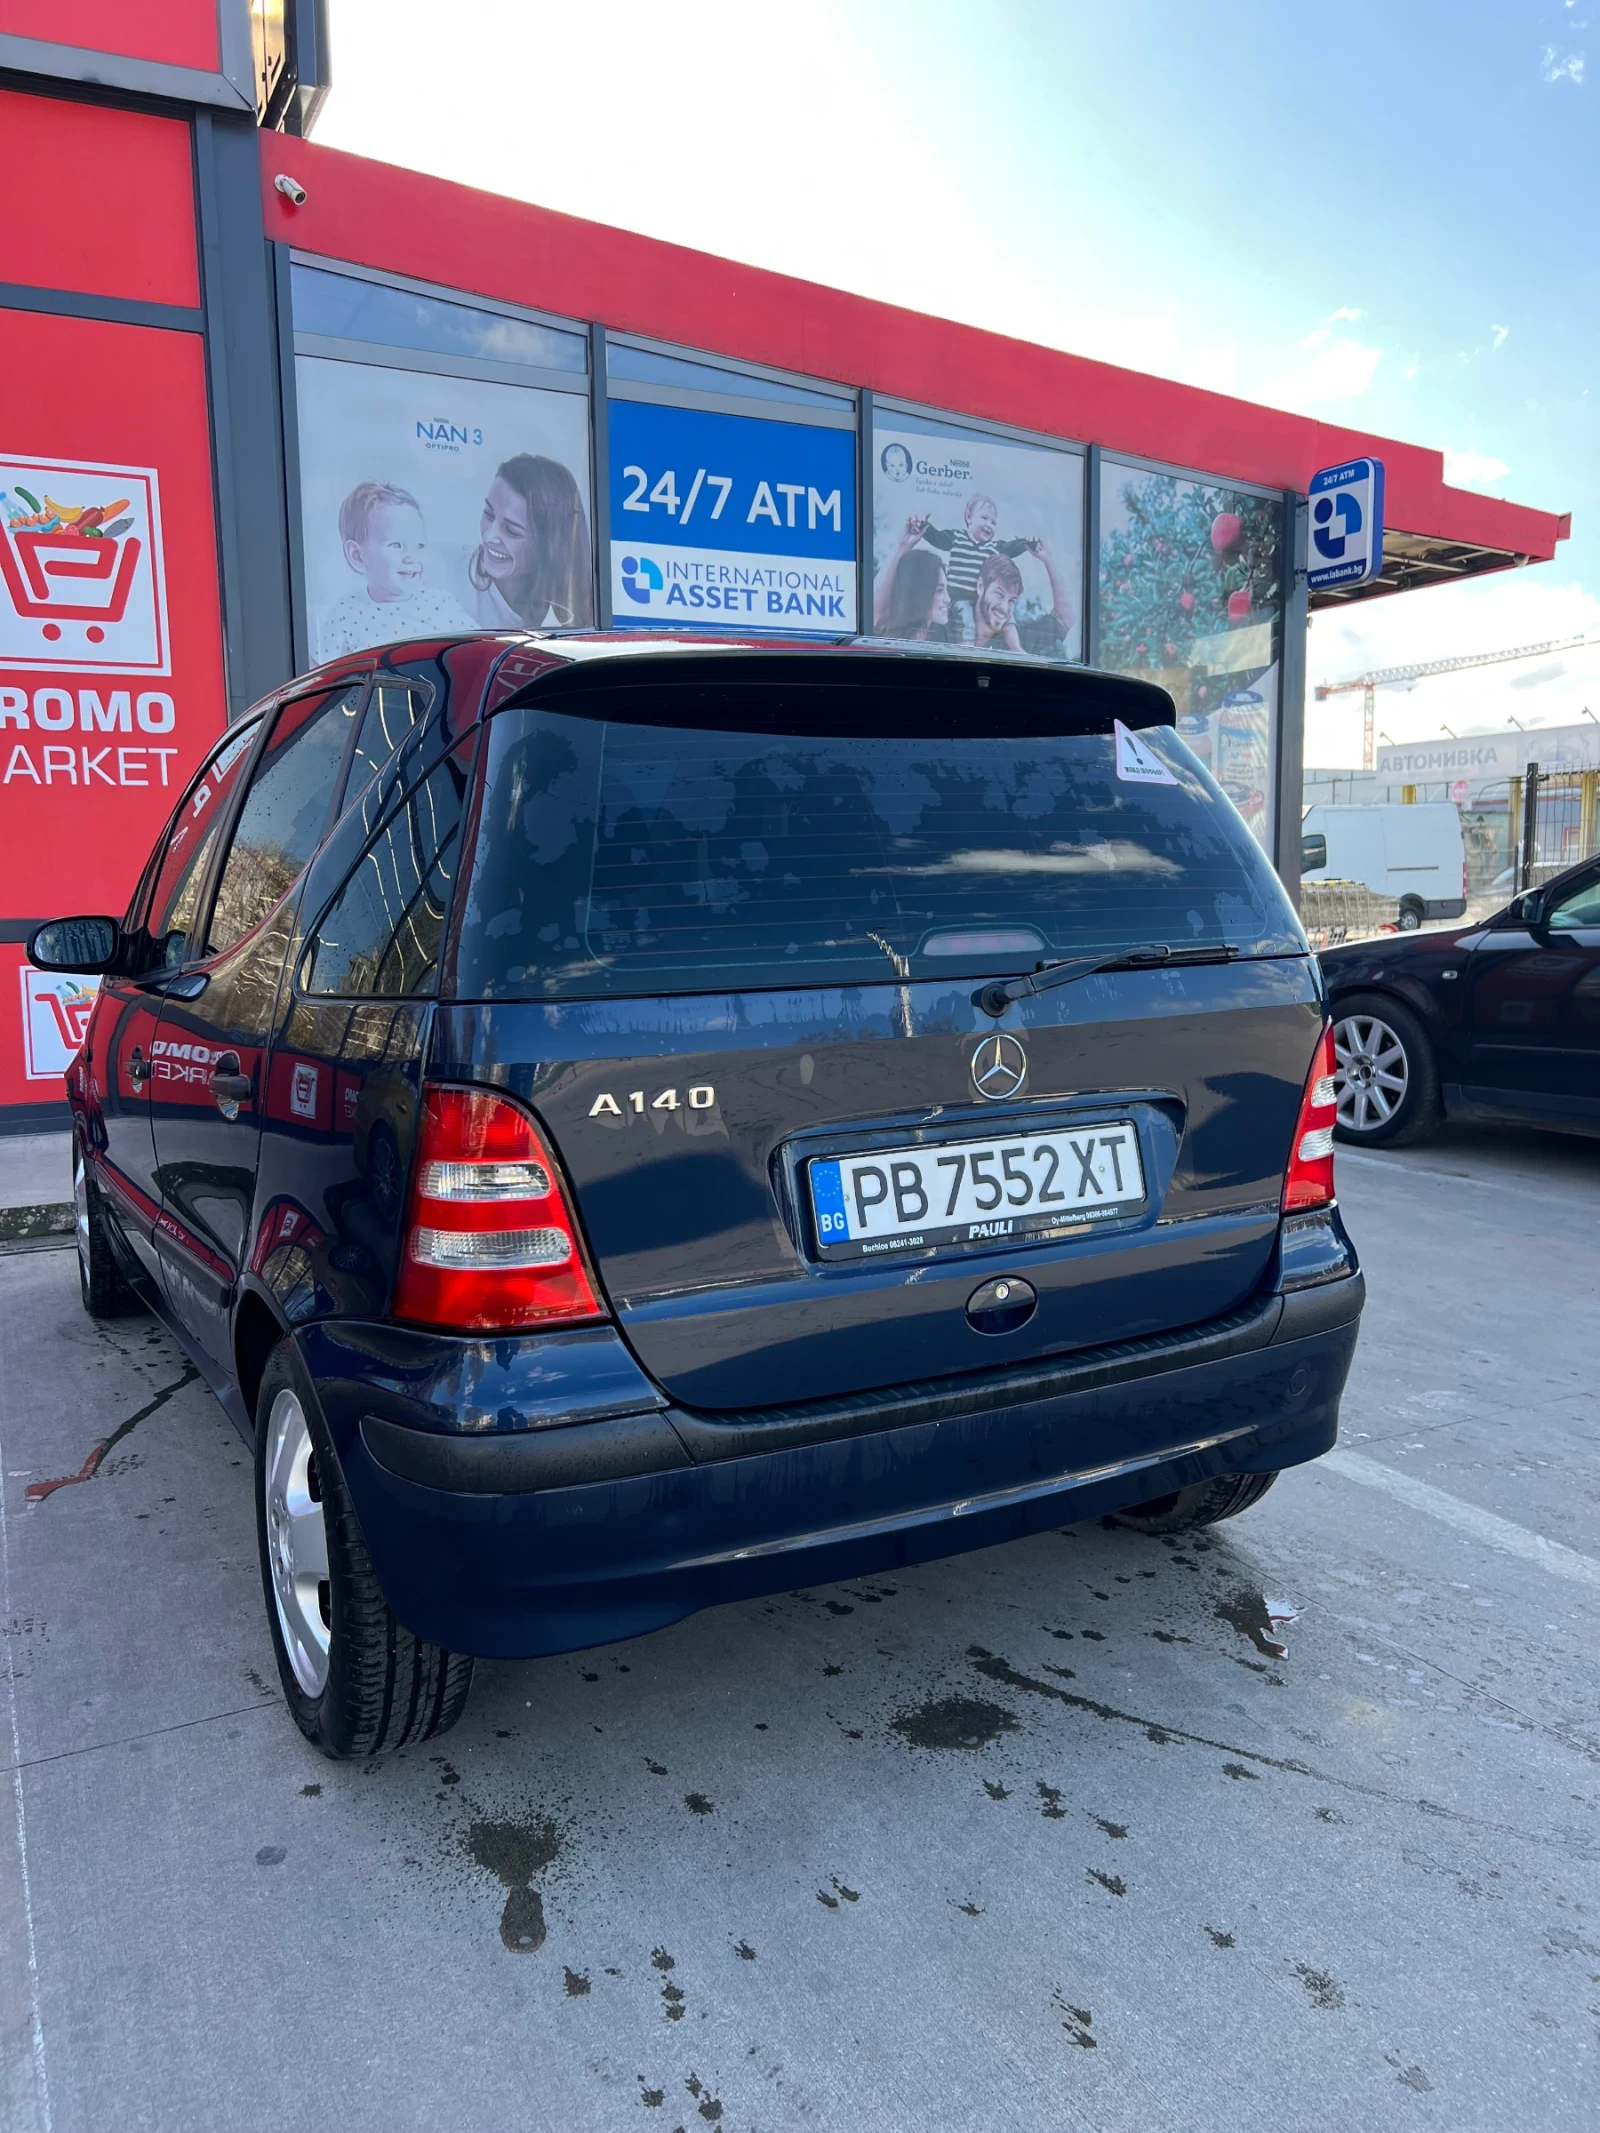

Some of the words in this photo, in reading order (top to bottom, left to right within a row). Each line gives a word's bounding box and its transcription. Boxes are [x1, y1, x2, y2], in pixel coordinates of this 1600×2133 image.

[416, 421, 468, 444] NAN
[473, 428, 483, 445] 3
[425, 442, 460, 452] OPTIPRO
[916, 460, 970, 480] Gerber
[1323, 474, 1338, 486] 24/7
[1339, 468, 1355, 481] ATM
[623, 465, 733, 525] 24/7
[746, 480, 841, 532] ATM
[666, 560, 845, 593] INTERNATIONAL
[666, 582, 759, 612] ASSET
[767, 590, 847, 618] BANK
[1380, 747, 1498, 773] АВТОМИВКА
[588, 1086, 715, 1117] A140
[820, 1212, 845, 1234] BG
[852, 1161, 929, 1228] PB
[937, 1144, 1065, 1216] 7552
[1069, 1135, 1126, 1198] XT
